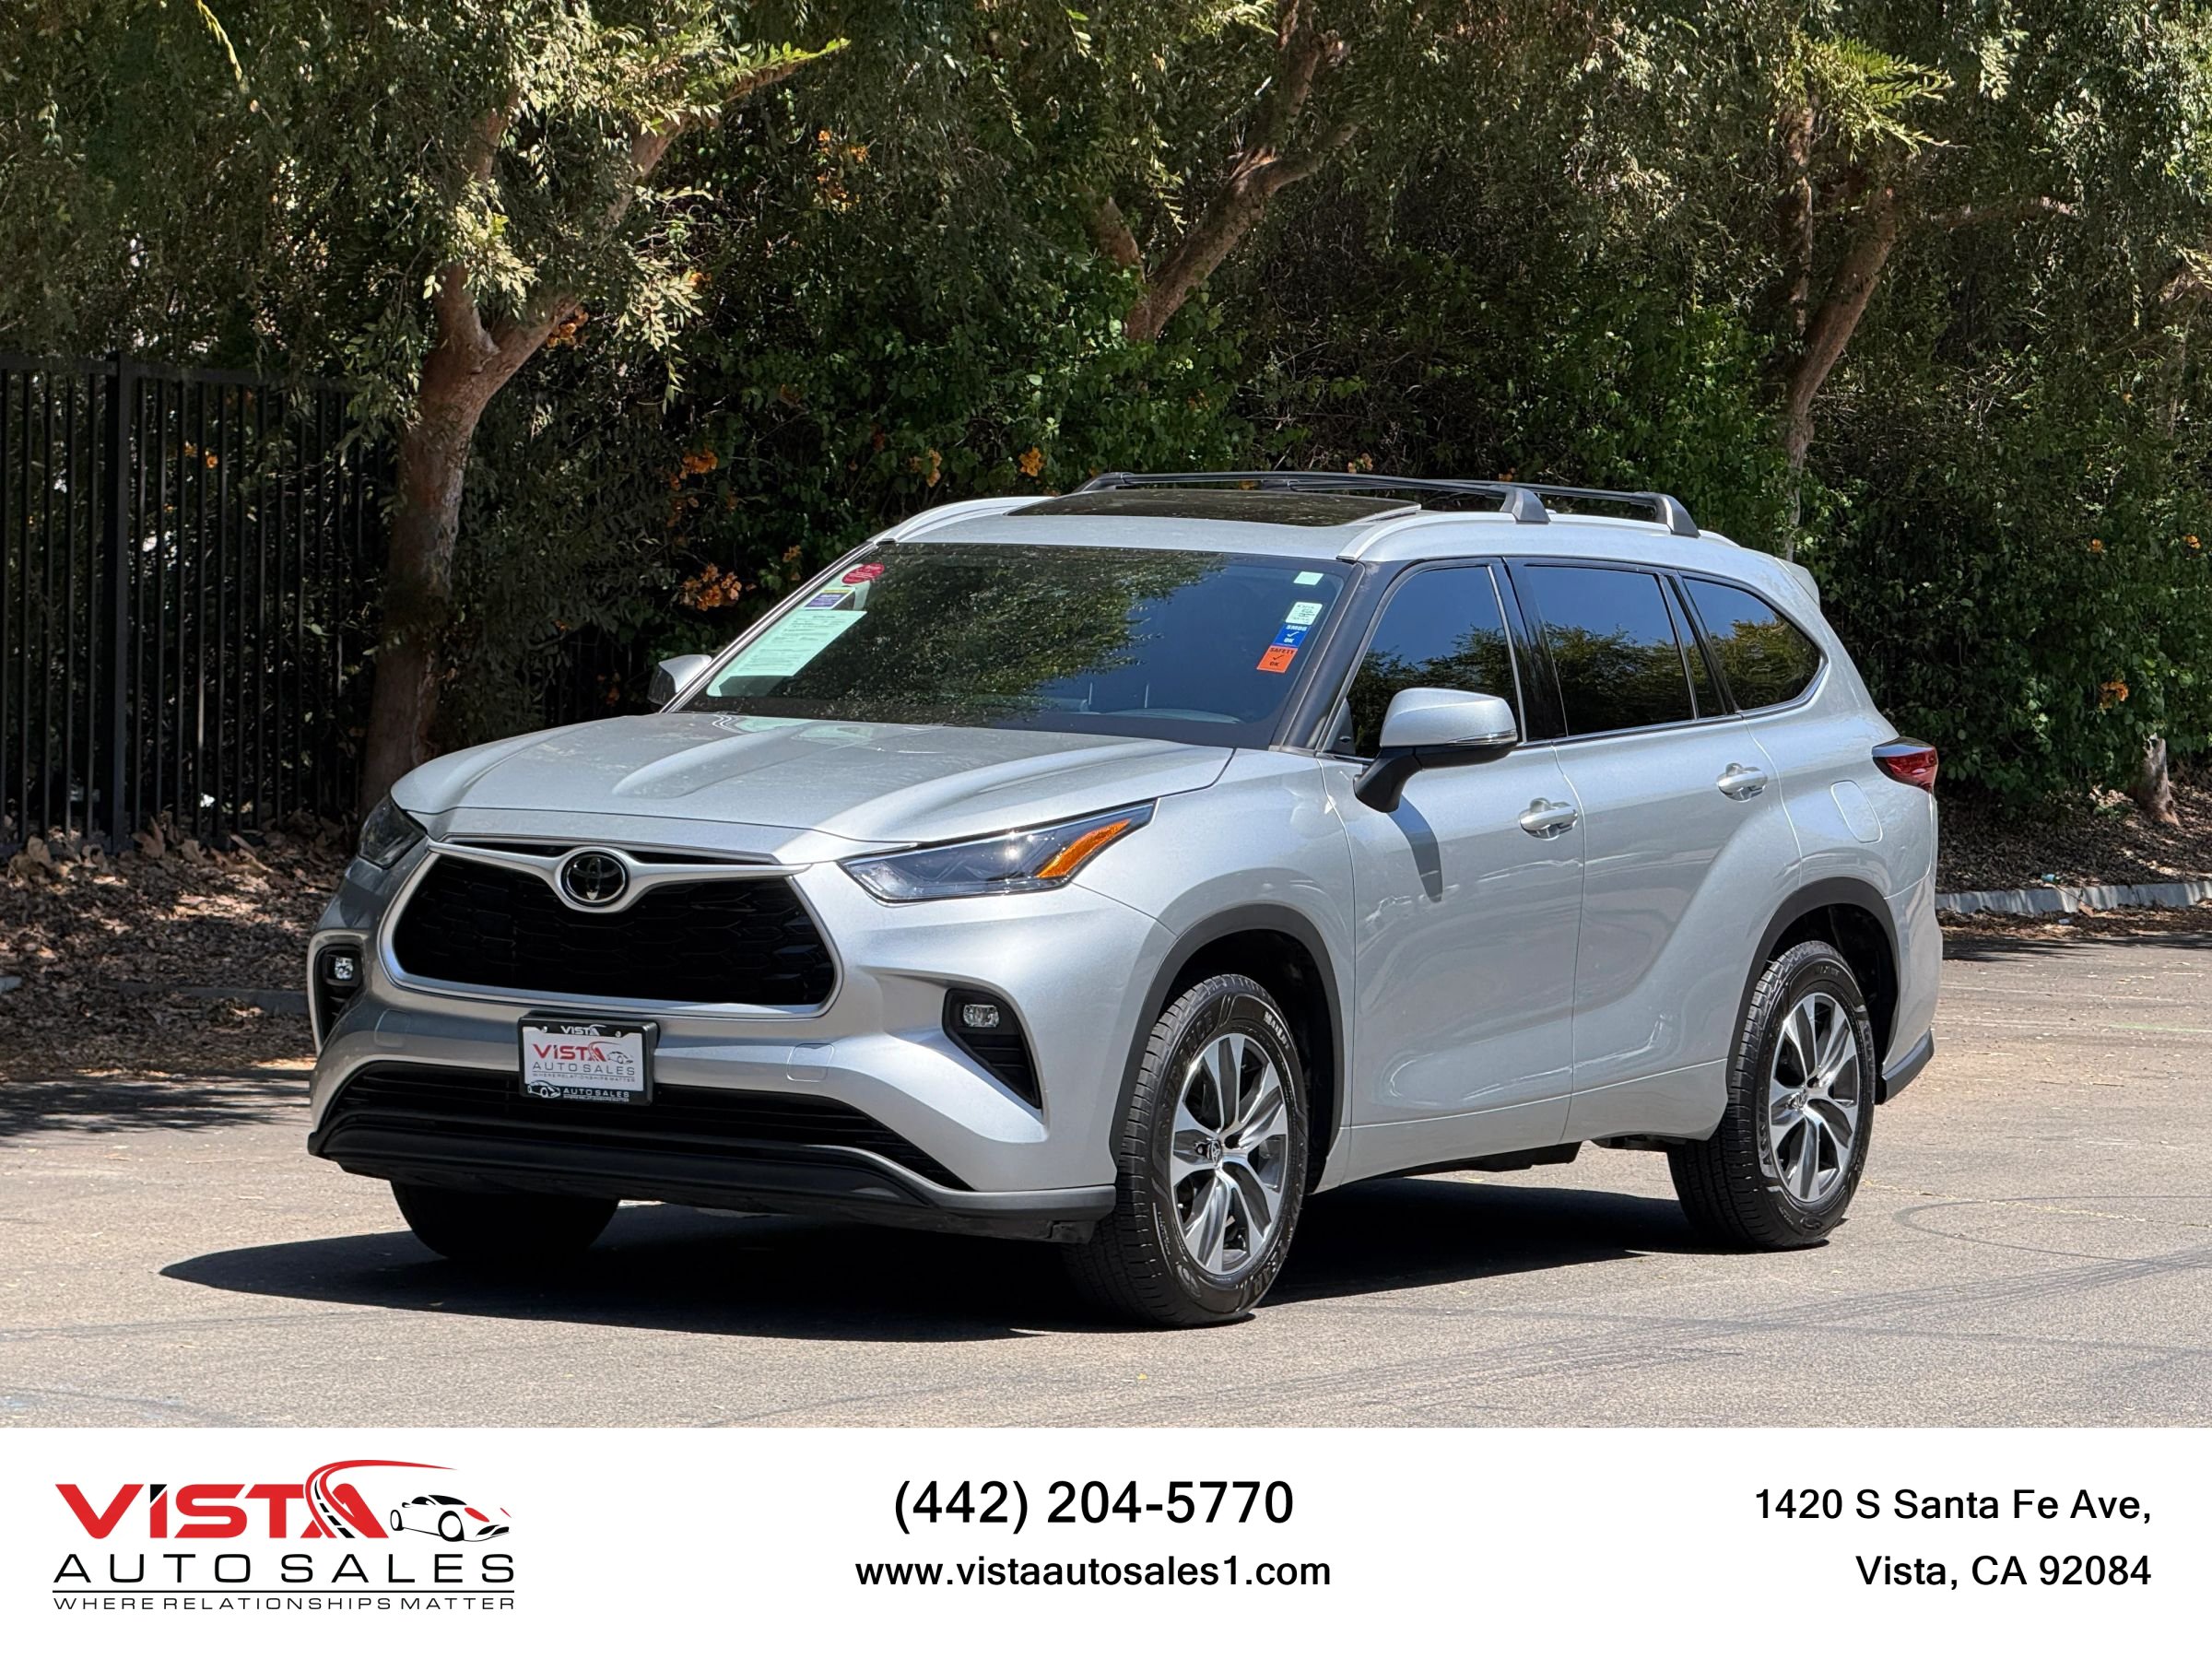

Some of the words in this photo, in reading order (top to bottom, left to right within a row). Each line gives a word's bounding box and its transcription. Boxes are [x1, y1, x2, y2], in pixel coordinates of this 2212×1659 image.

[560, 1024, 603, 1036] VISTA
[533, 1042, 606, 1062] VISTA
[533, 1062, 577, 1072] AUTO
[583, 1064, 635, 1076] SALES
[563, 1088, 593, 1096] AUTO
[595, 1088, 630, 1098] SALES
